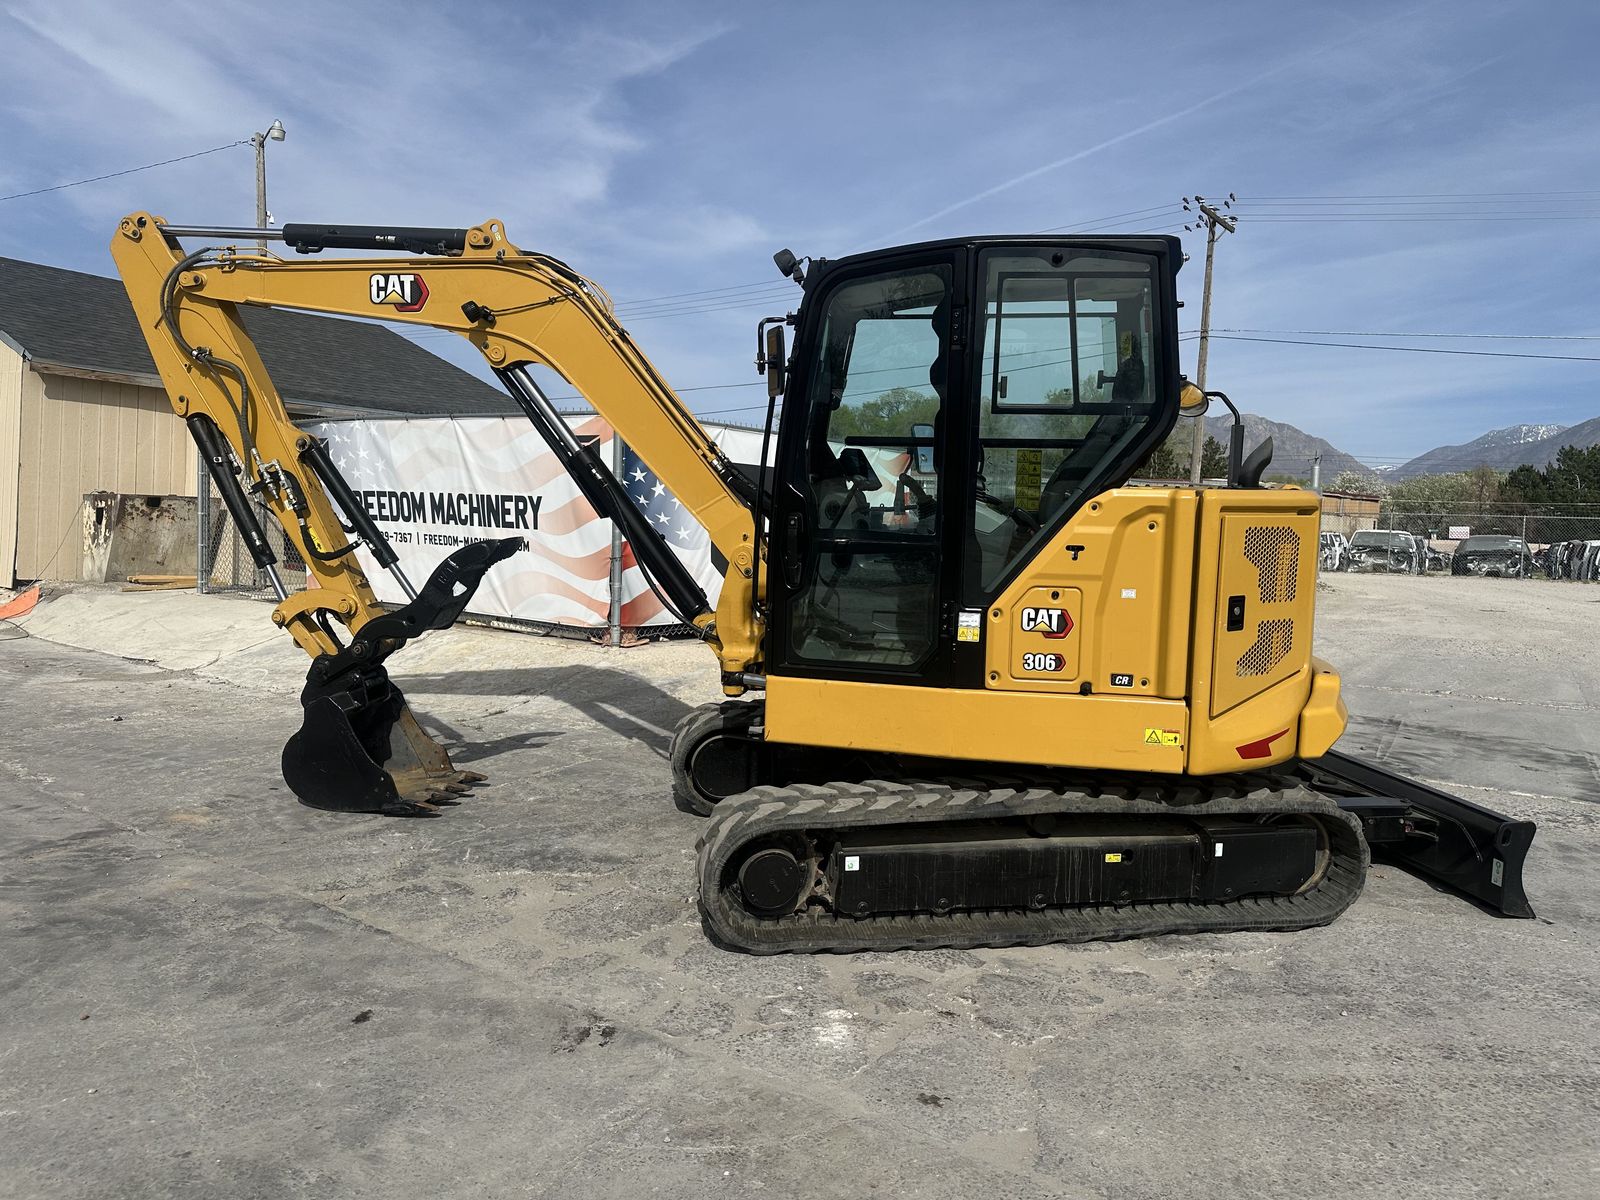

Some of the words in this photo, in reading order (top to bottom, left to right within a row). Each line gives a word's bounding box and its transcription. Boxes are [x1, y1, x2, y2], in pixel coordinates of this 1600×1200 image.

[370, 274, 415, 304] CAT
[352, 490, 427, 523] EEDOM
[429, 492, 543, 530] MACHINERY
[1021, 608, 1062, 632] CAT
[1023, 653, 1056, 670] 306
[1115, 675, 1129, 685] CR
